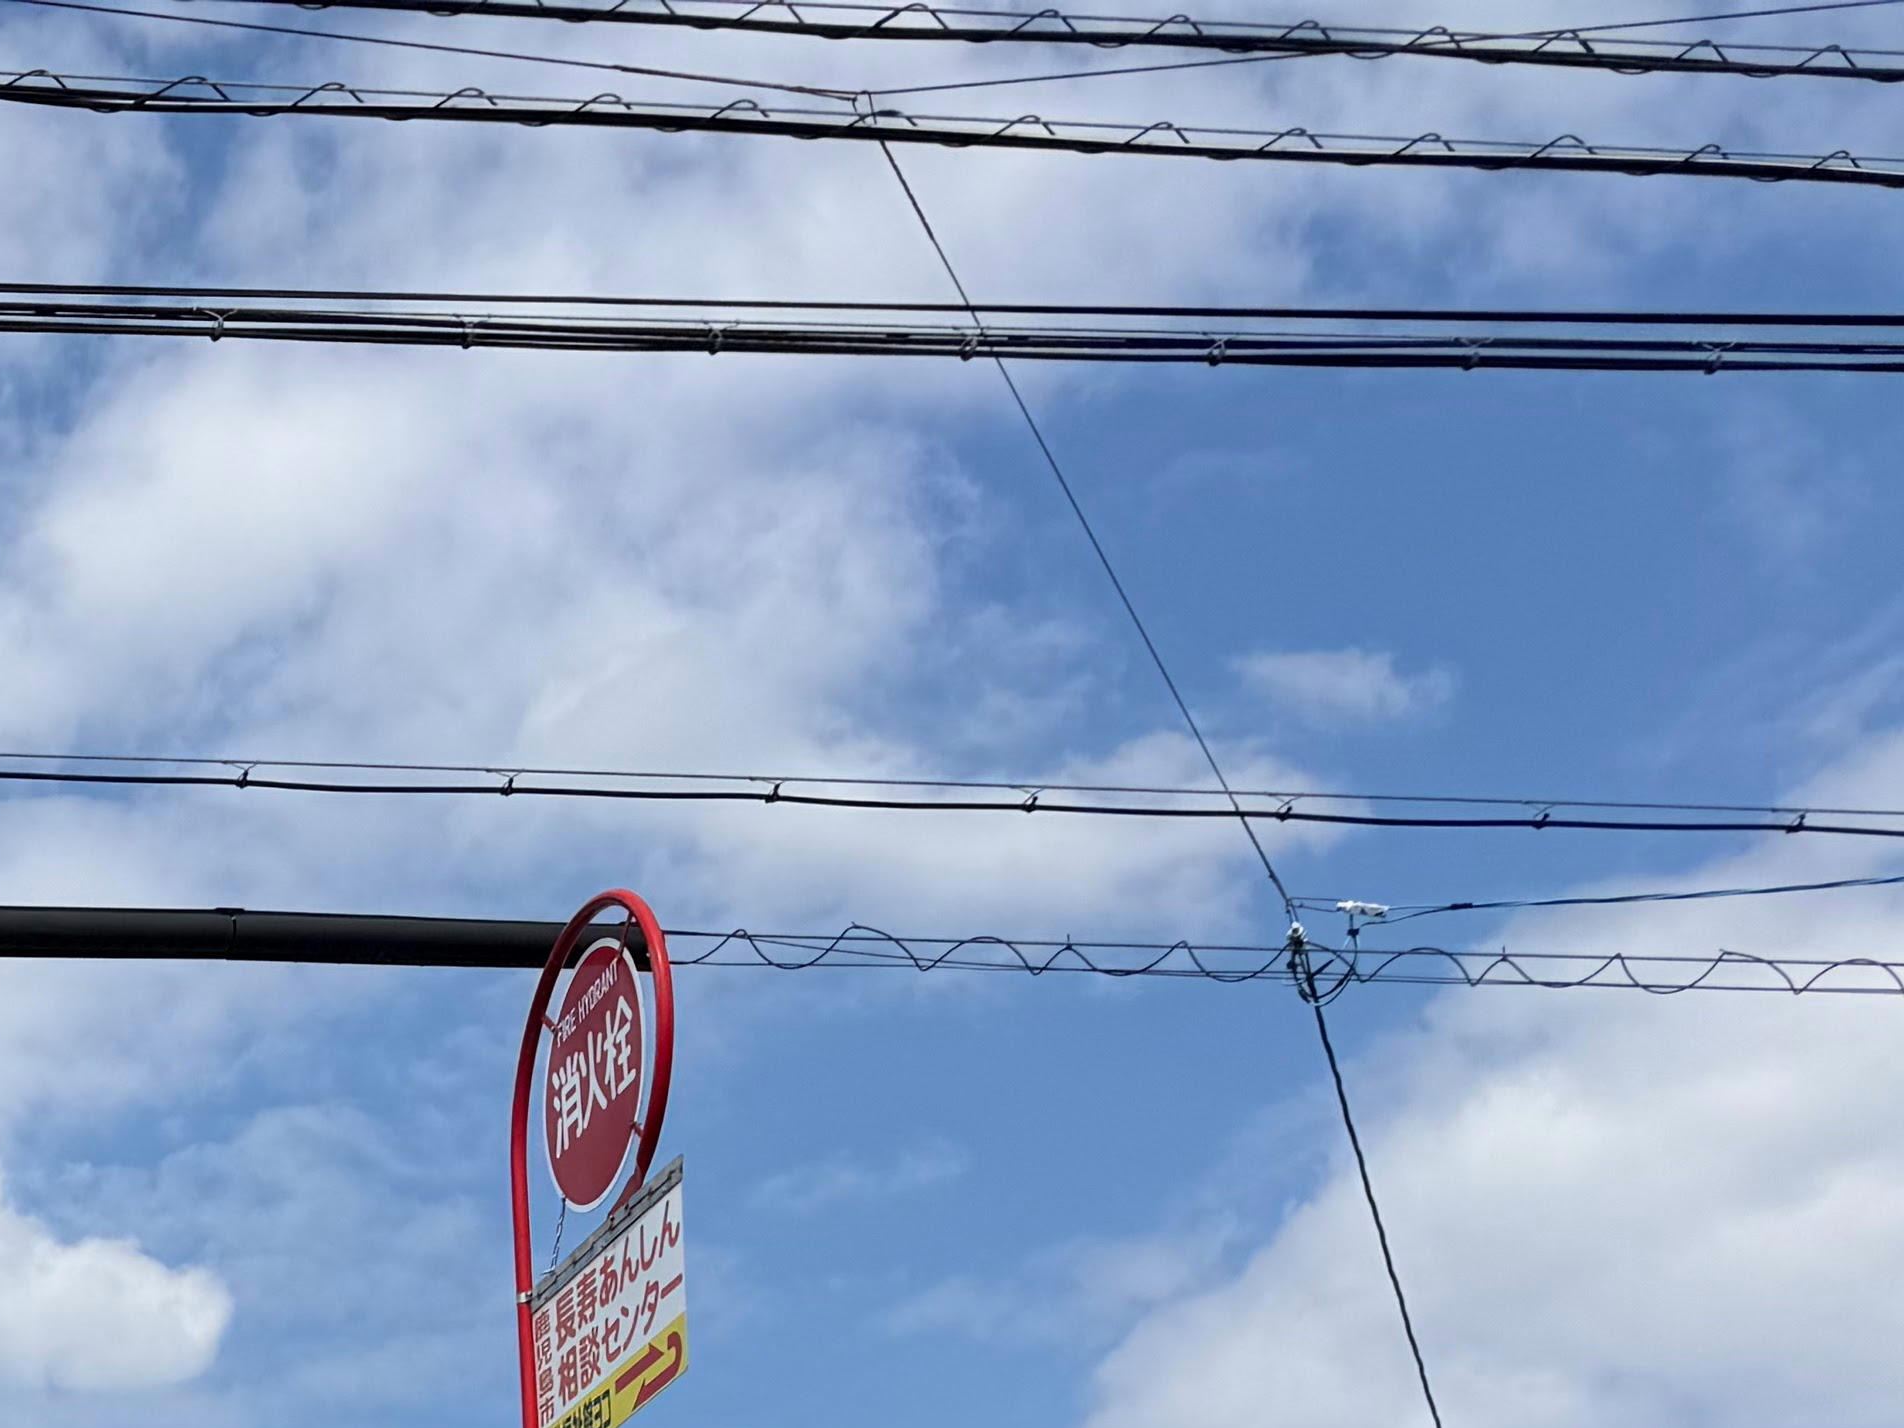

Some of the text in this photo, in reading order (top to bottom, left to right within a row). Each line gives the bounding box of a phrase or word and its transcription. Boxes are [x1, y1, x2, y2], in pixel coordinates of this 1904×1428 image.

[557, 957, 620, 1048] FIRE HYDRANT
[552, 995, 636, 1159] 消火栓
[555, 1200, 680, 1352] 長寿あんしん
[558, 1273, 683, 1407] 相談センター
[535, 1308, 554, 1428] 鹿児島市
